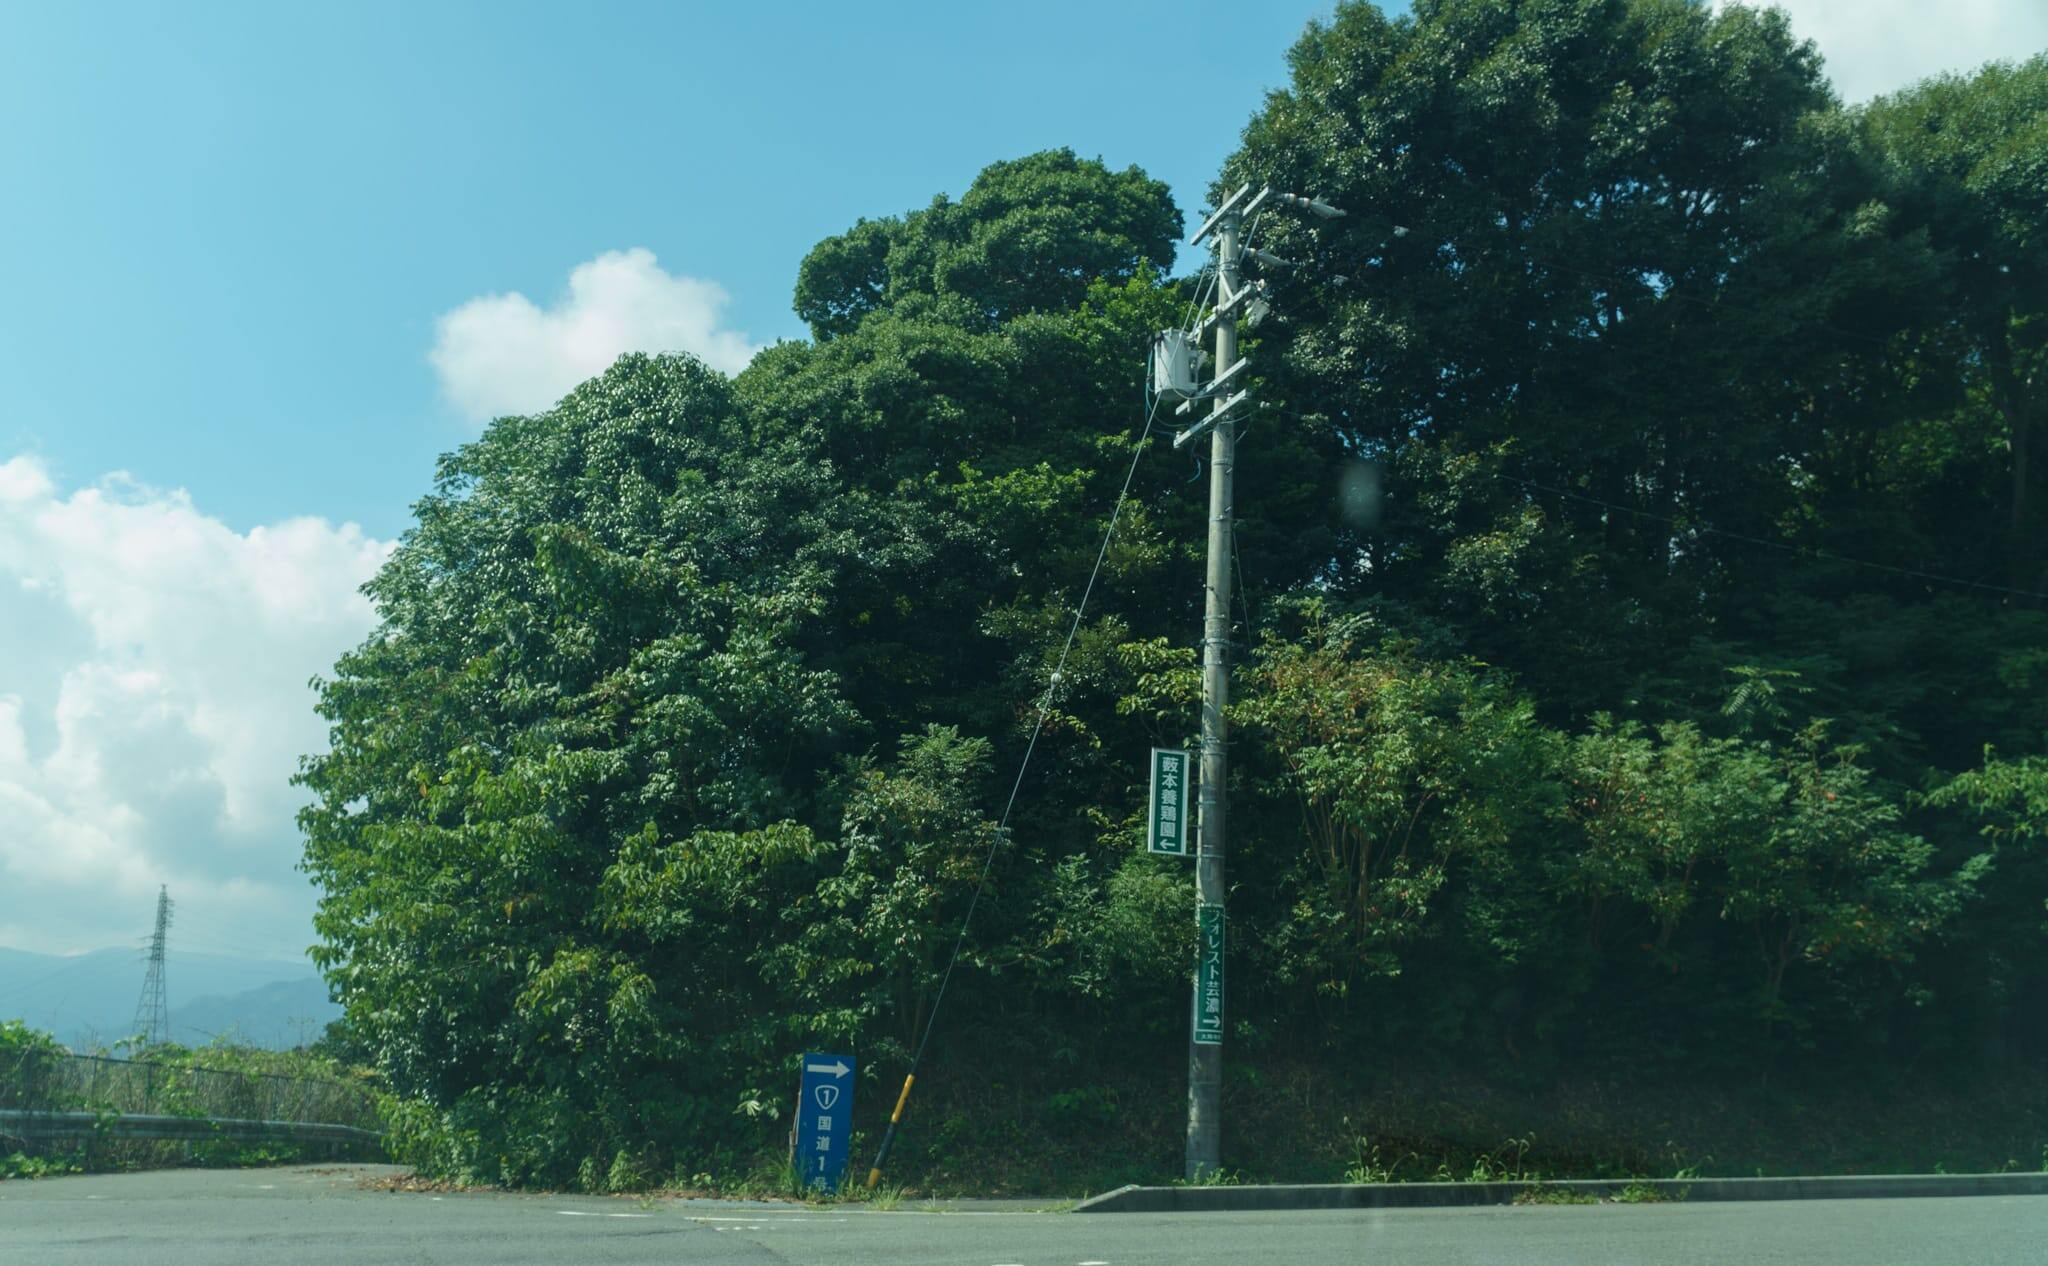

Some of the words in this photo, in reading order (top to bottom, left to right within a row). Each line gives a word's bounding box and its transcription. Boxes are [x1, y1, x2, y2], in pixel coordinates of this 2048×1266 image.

[1206, 911, 1220, 1013] フォレスト芸濃
[822, 1089, 830, 1105] 1
